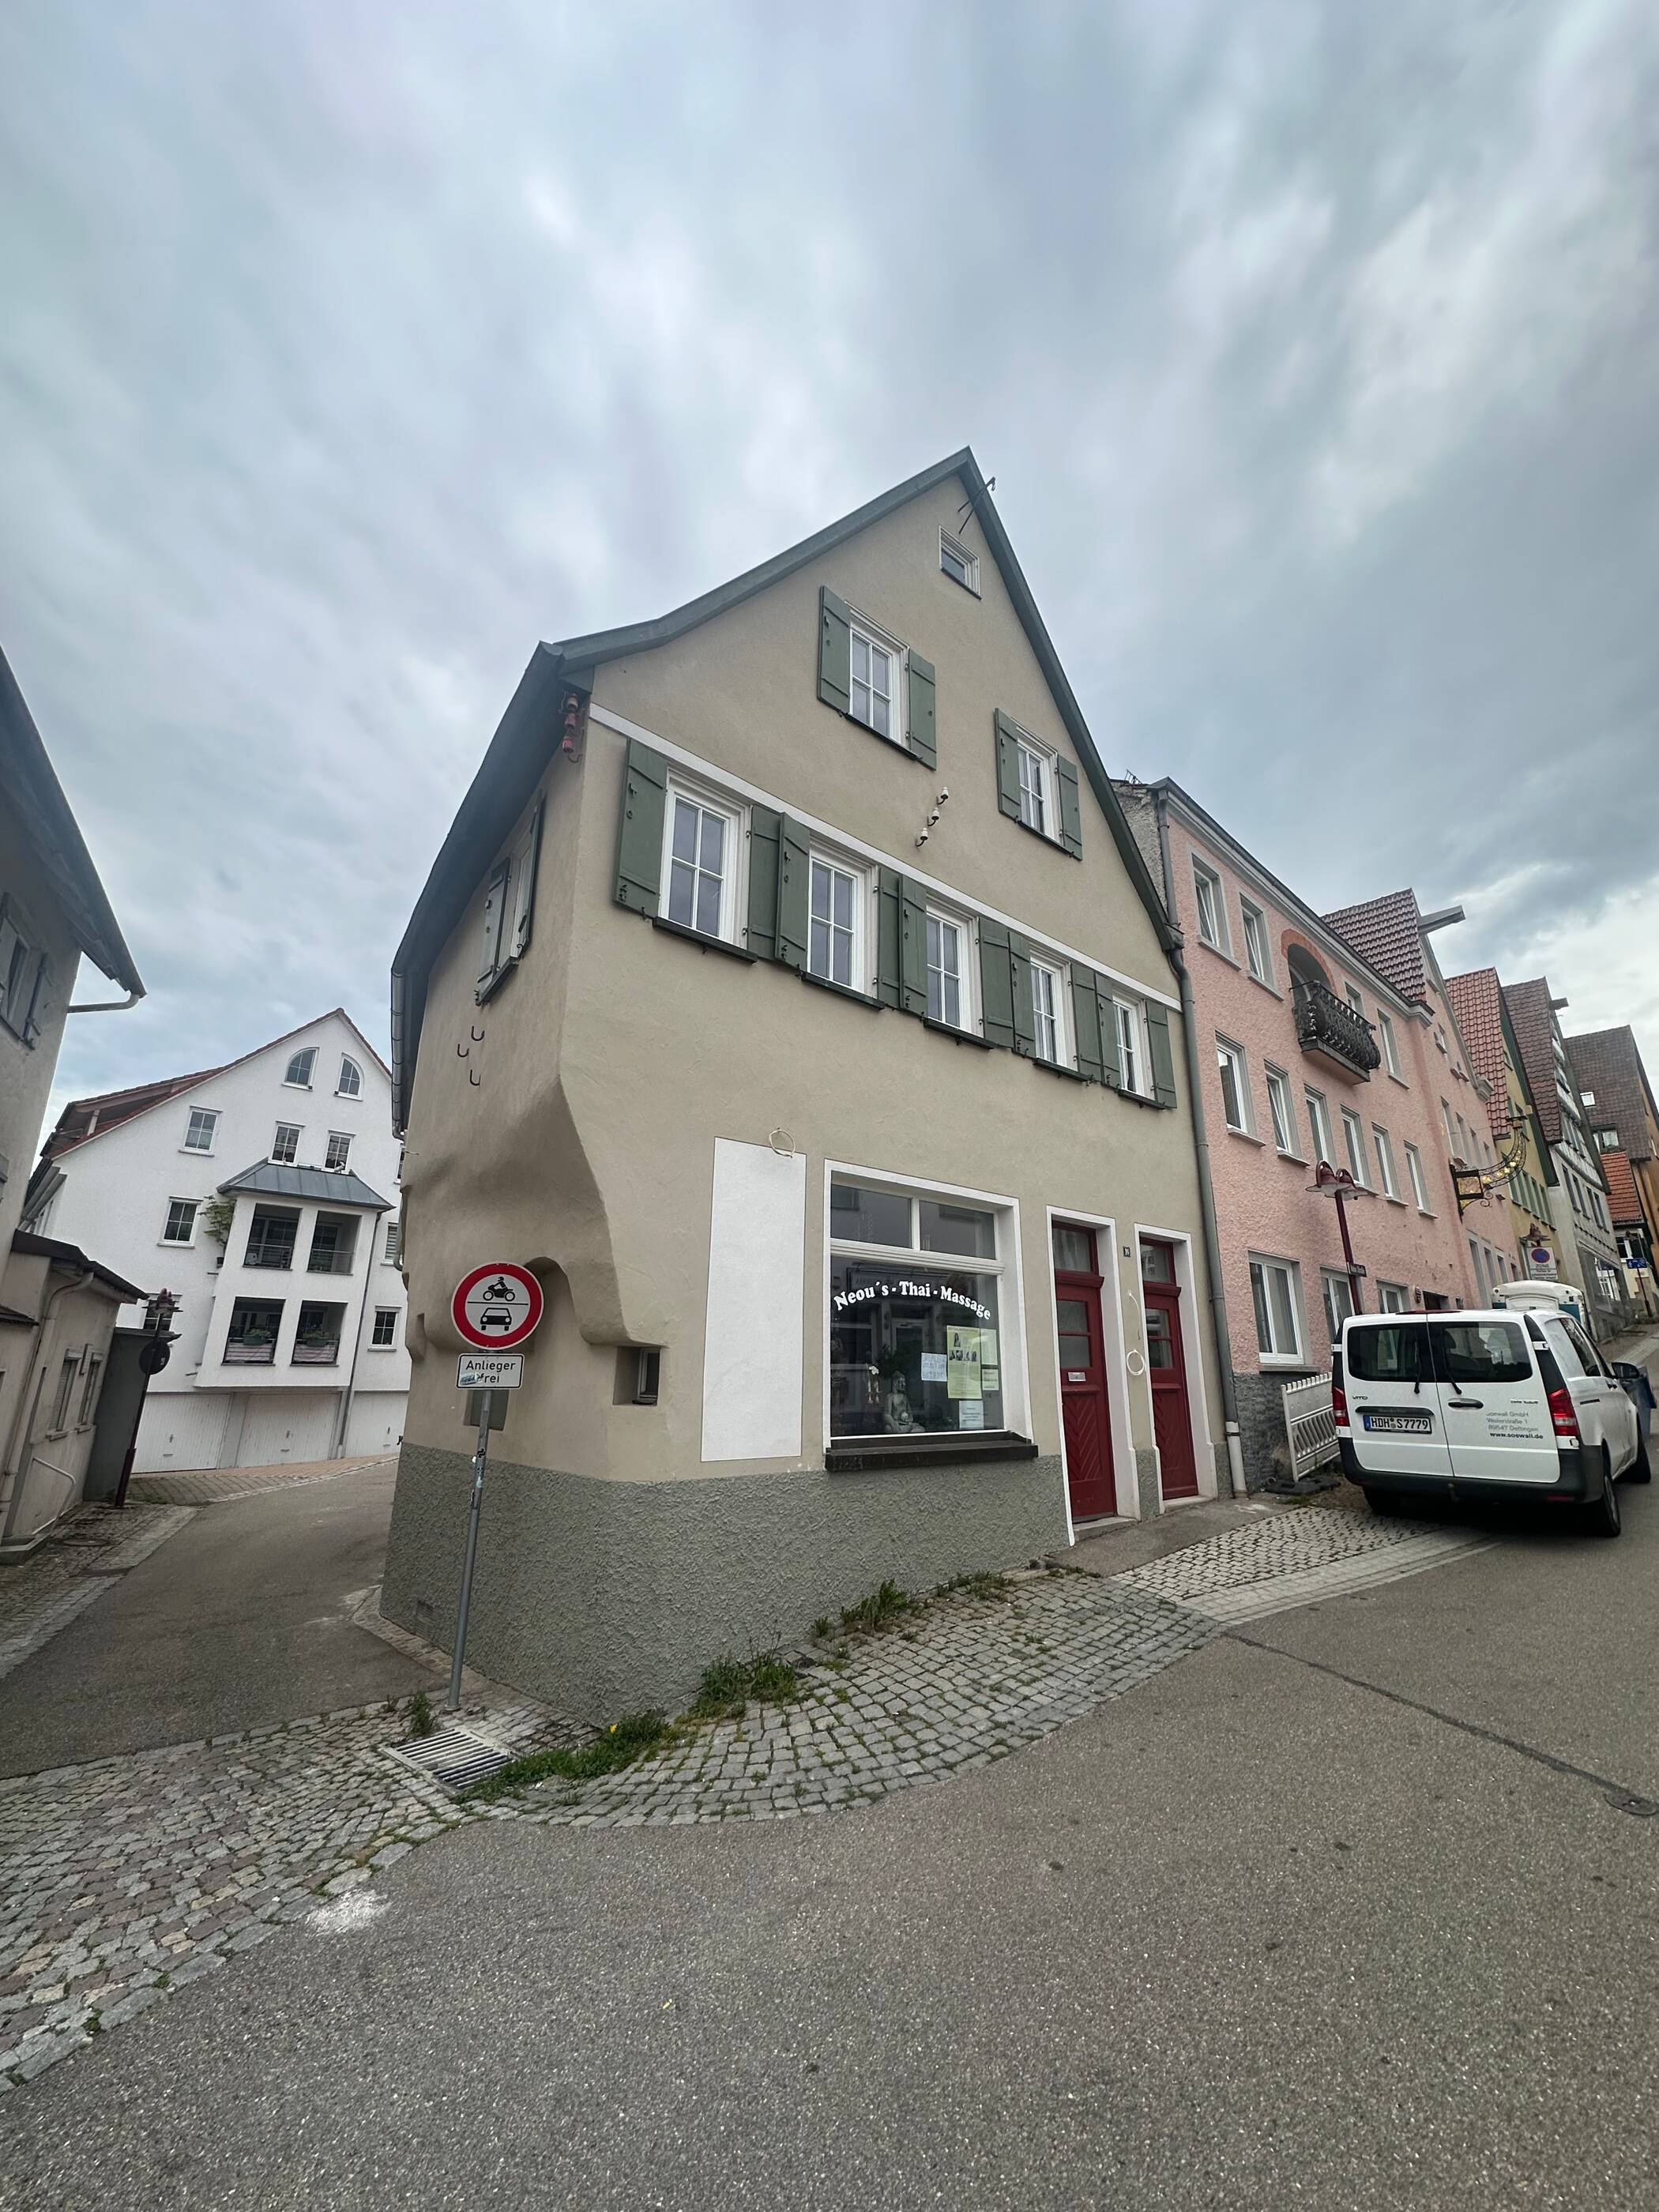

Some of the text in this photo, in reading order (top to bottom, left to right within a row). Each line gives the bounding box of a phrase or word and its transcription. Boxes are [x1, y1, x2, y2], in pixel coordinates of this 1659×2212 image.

[899, 1281, 931, 1297] Thai
[940, 1285, 991, 1320] Massage
[466, 1360, 516, 1372] Anlieger
[1371, 1417, 1390, 1428] HDH
